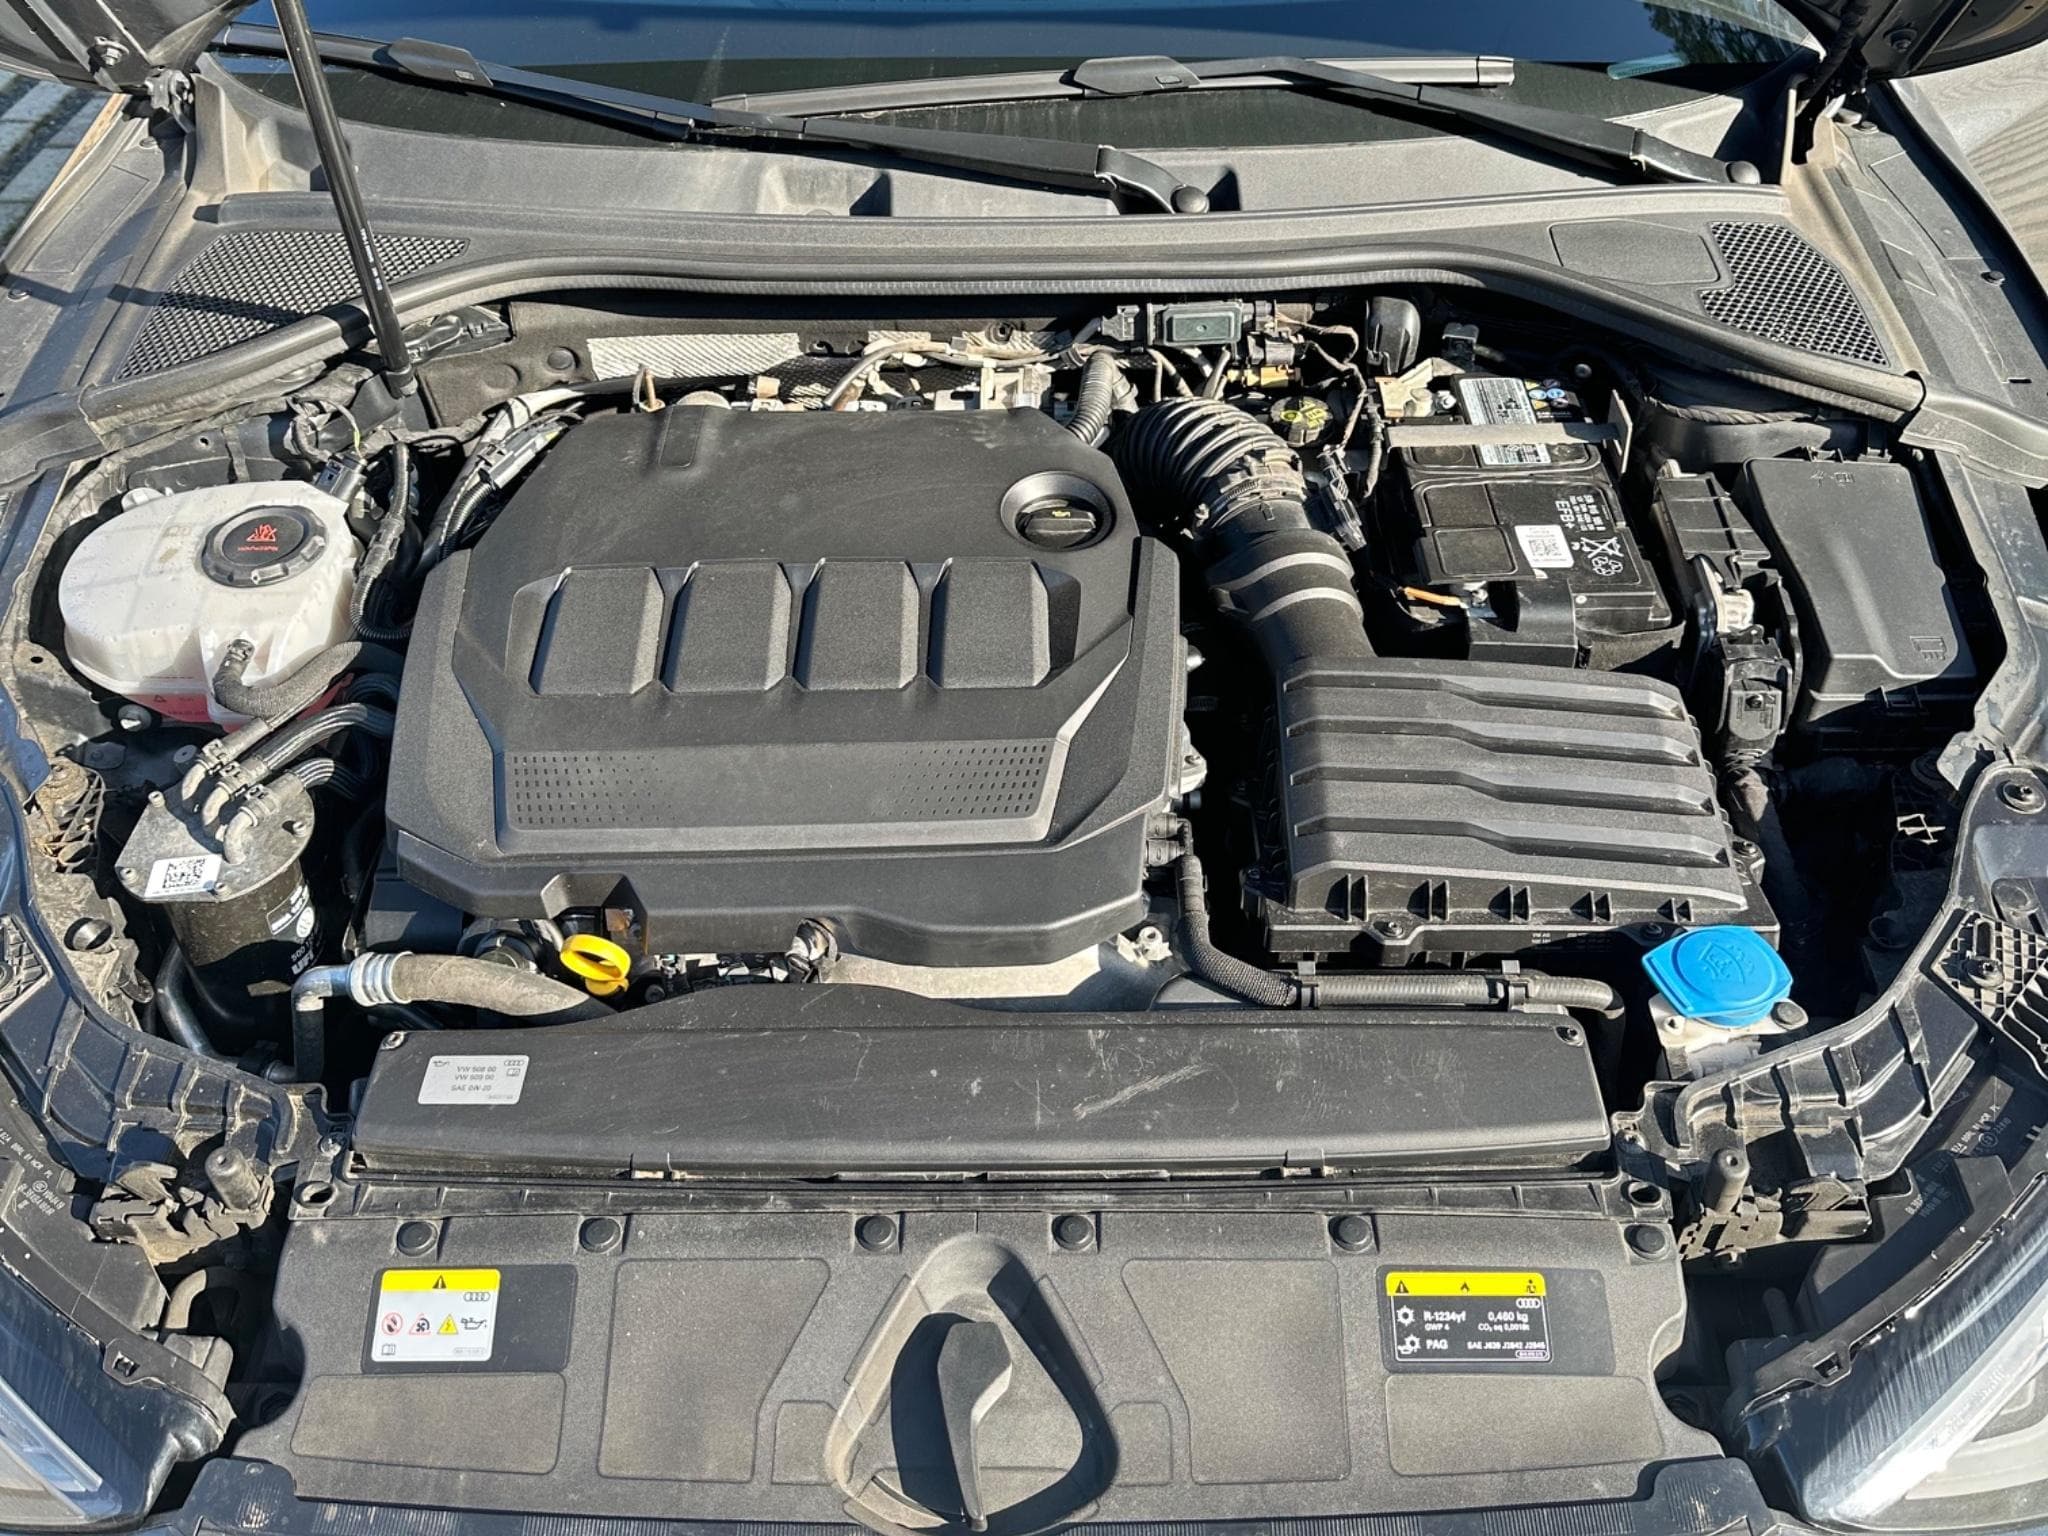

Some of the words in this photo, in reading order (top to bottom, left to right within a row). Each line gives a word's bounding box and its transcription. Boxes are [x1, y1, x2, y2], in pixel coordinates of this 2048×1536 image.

[1555, 500, 1576, 529] EFB+
[1423, 1310, 1466, 1323] R-1234yf
[1516, 1310, 1529, 1323] kg
[1426, 1340, 1448, 1350] PAG
